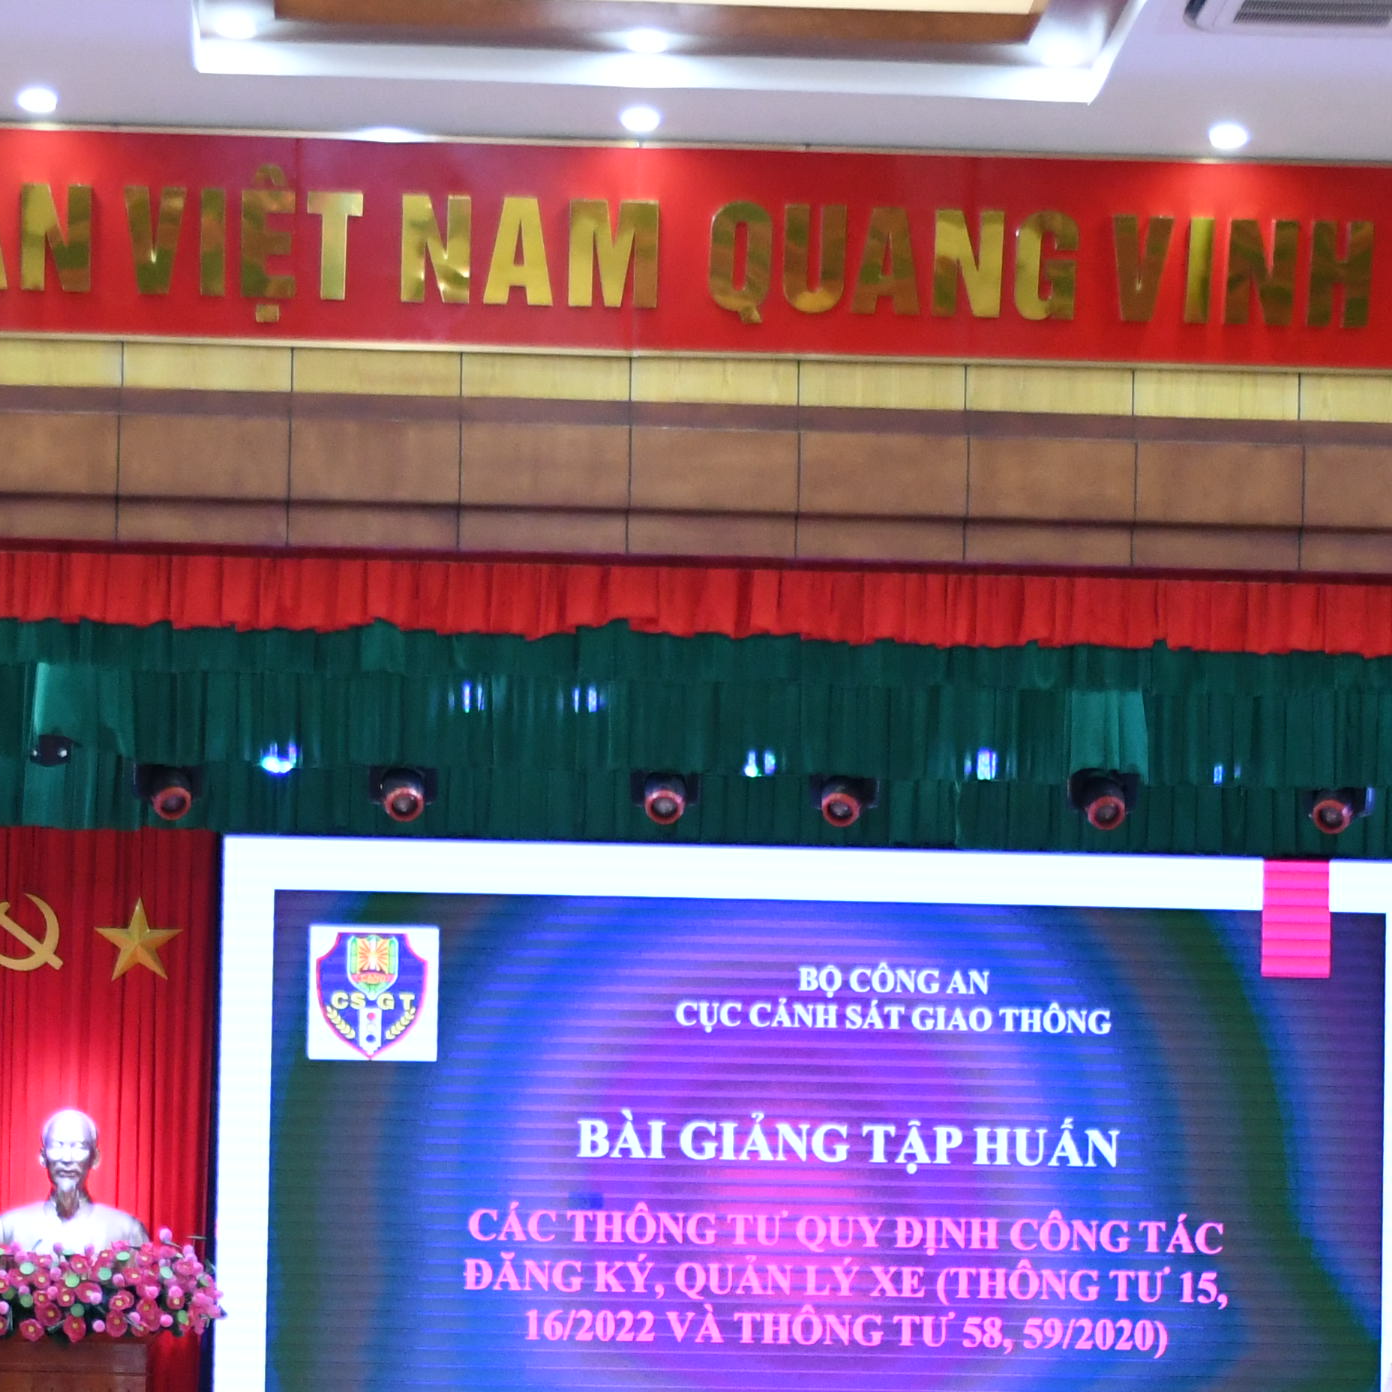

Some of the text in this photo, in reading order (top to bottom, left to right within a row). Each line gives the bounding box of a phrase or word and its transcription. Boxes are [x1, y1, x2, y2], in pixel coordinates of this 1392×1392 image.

[125, 164, 363, 323] VIỆT
[401, 193, 660, 309] NAM
[711, 201, 1079, 323] QUANG
[1113, 215, 1374, 328] VINH
[799, 959, 990, 998] BỘ CÔNG AN
[676, 995, 1112, 1035] CỤC CẢNH SÁT GIAO THÔNG
[577, 1107, 1121, 1173] BÀI GIẢNG TẬP HUẤN
[468, 1201, 1224, 1256] CÁC THÔNG TƯ QUY ĐỊNH CÔNG TÁC
[463, 1251, 1229, 1310] ĐĂNG KÝ, QUẢN LÝ XE (THÔNG TƯ 15,
[525, 1303, 1169, 1359] 16/2022 VÀ THÔNG TƯ 58, 59/2020)
